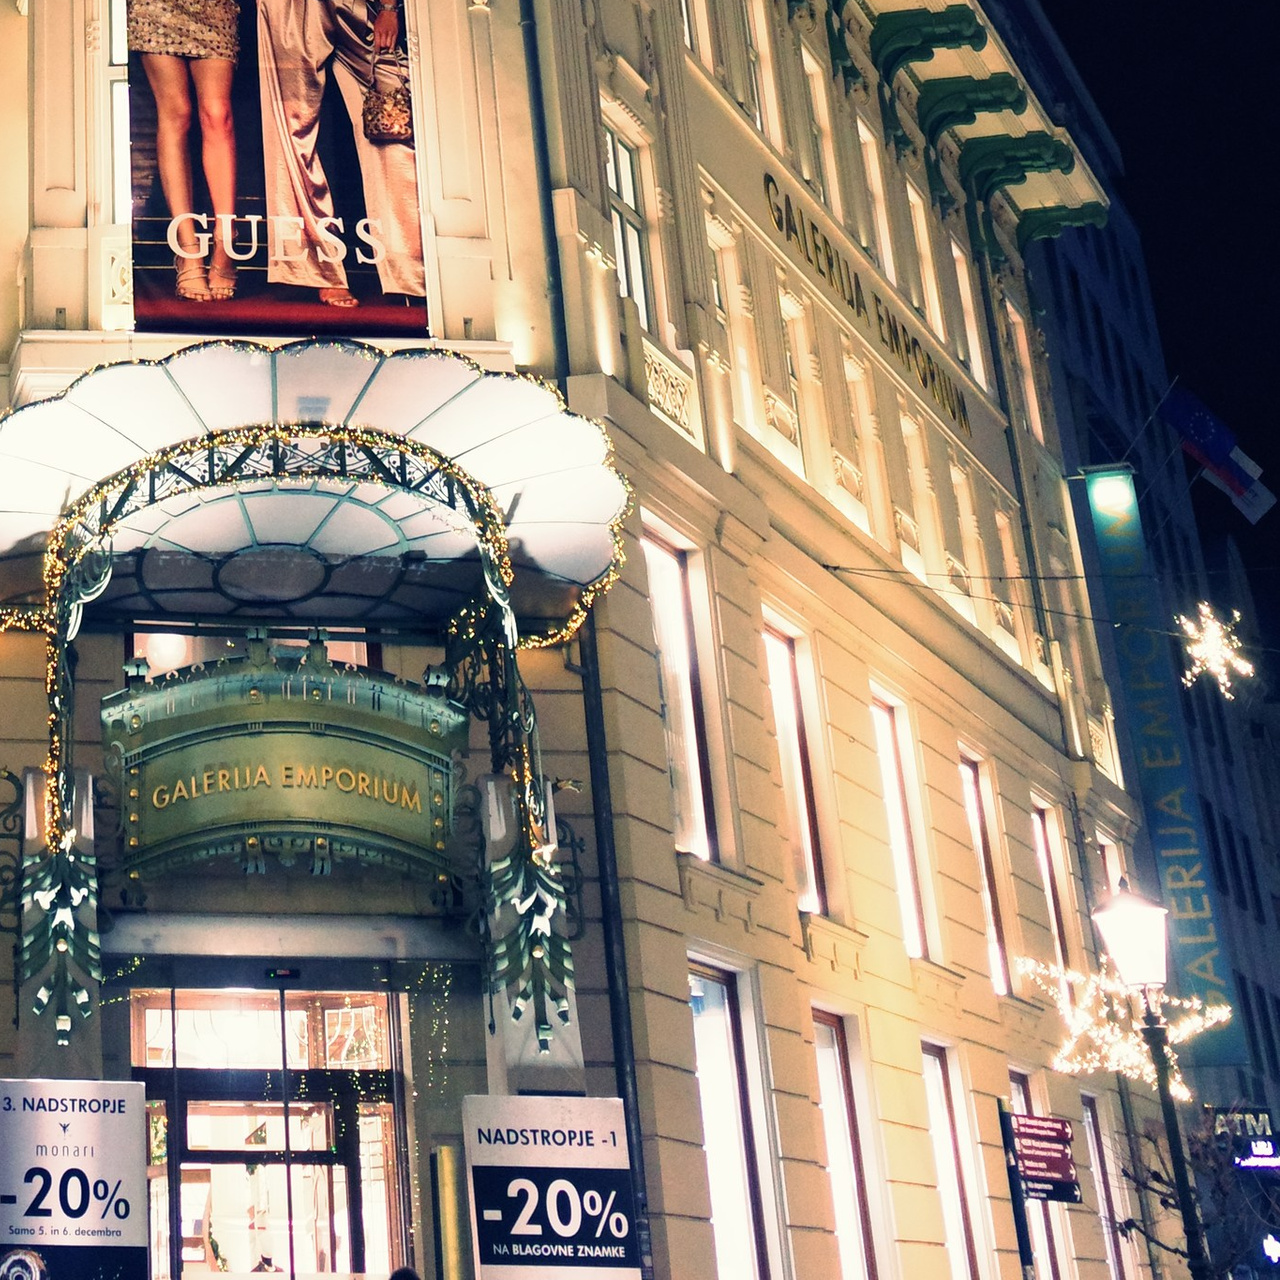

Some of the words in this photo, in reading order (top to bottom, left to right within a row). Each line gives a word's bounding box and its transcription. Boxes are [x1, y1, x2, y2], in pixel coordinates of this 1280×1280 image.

[167, 213, 387, 265] GUESS
[763, 172, 871, 329] GALERIJA
[873, 291, 972, 438] EMPORIUM
[152, 764, 270, 809] GALERIJA
[281, 764, 422, 814] EMPORIUM
[3, 1096, 16, 1112] 3.
[22, 1097, 126, 1114] NADSTROPJE
[1214, 1113, 1273, 1136] ATM
[477, 1128, 595, 1147] NADSTROPJE
[602, 1131, 617, 1147] -1
[35, 1144, 95, 1158] monari
[0, 1167, 131, 1220] -20%
[483, 1178, 629, 1239] -20%
[8, 1225, 36, 1236] Samo
[38, 1226, 48, 1236] 5.
[51, 1226, 60, 1236] in
[62, 1226, 72, 1236] 6.
[75, 1226, 122, 1237] decembra
[493, 1243, 510, 1255] NA
[512, 1244, 575, 1257] BLAGOVNE
[577, 1245, 625, 1258] ZNAMKE
